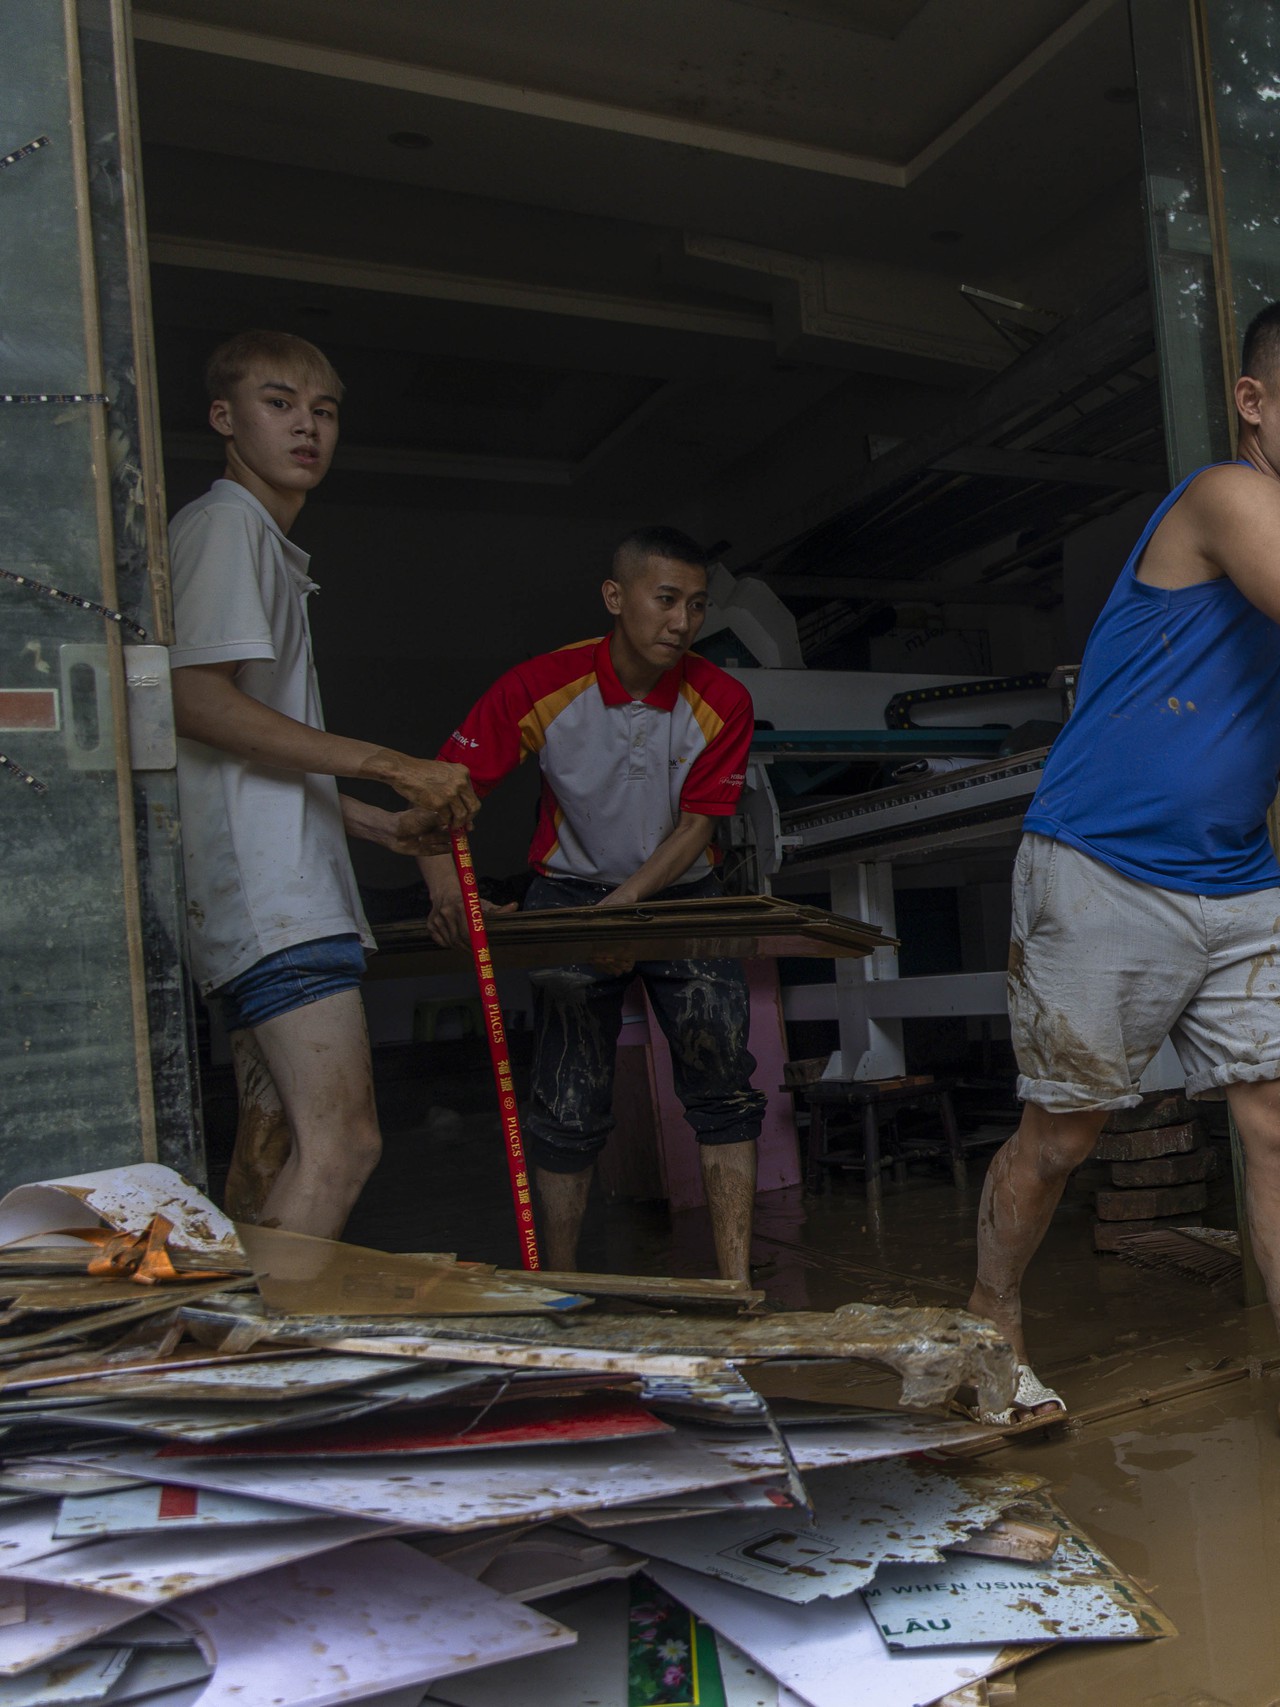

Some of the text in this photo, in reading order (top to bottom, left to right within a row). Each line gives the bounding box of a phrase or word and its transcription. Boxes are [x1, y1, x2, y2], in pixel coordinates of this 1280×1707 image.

[467, 892, 485, 932] PIACES
[488, 1003, 504, 1043] PIACES
[507, 1116, 522, 1157] PIACES
[524, 1229, 539, 1269] PIACES
[892, 1582, 968, 1594] WHEN
